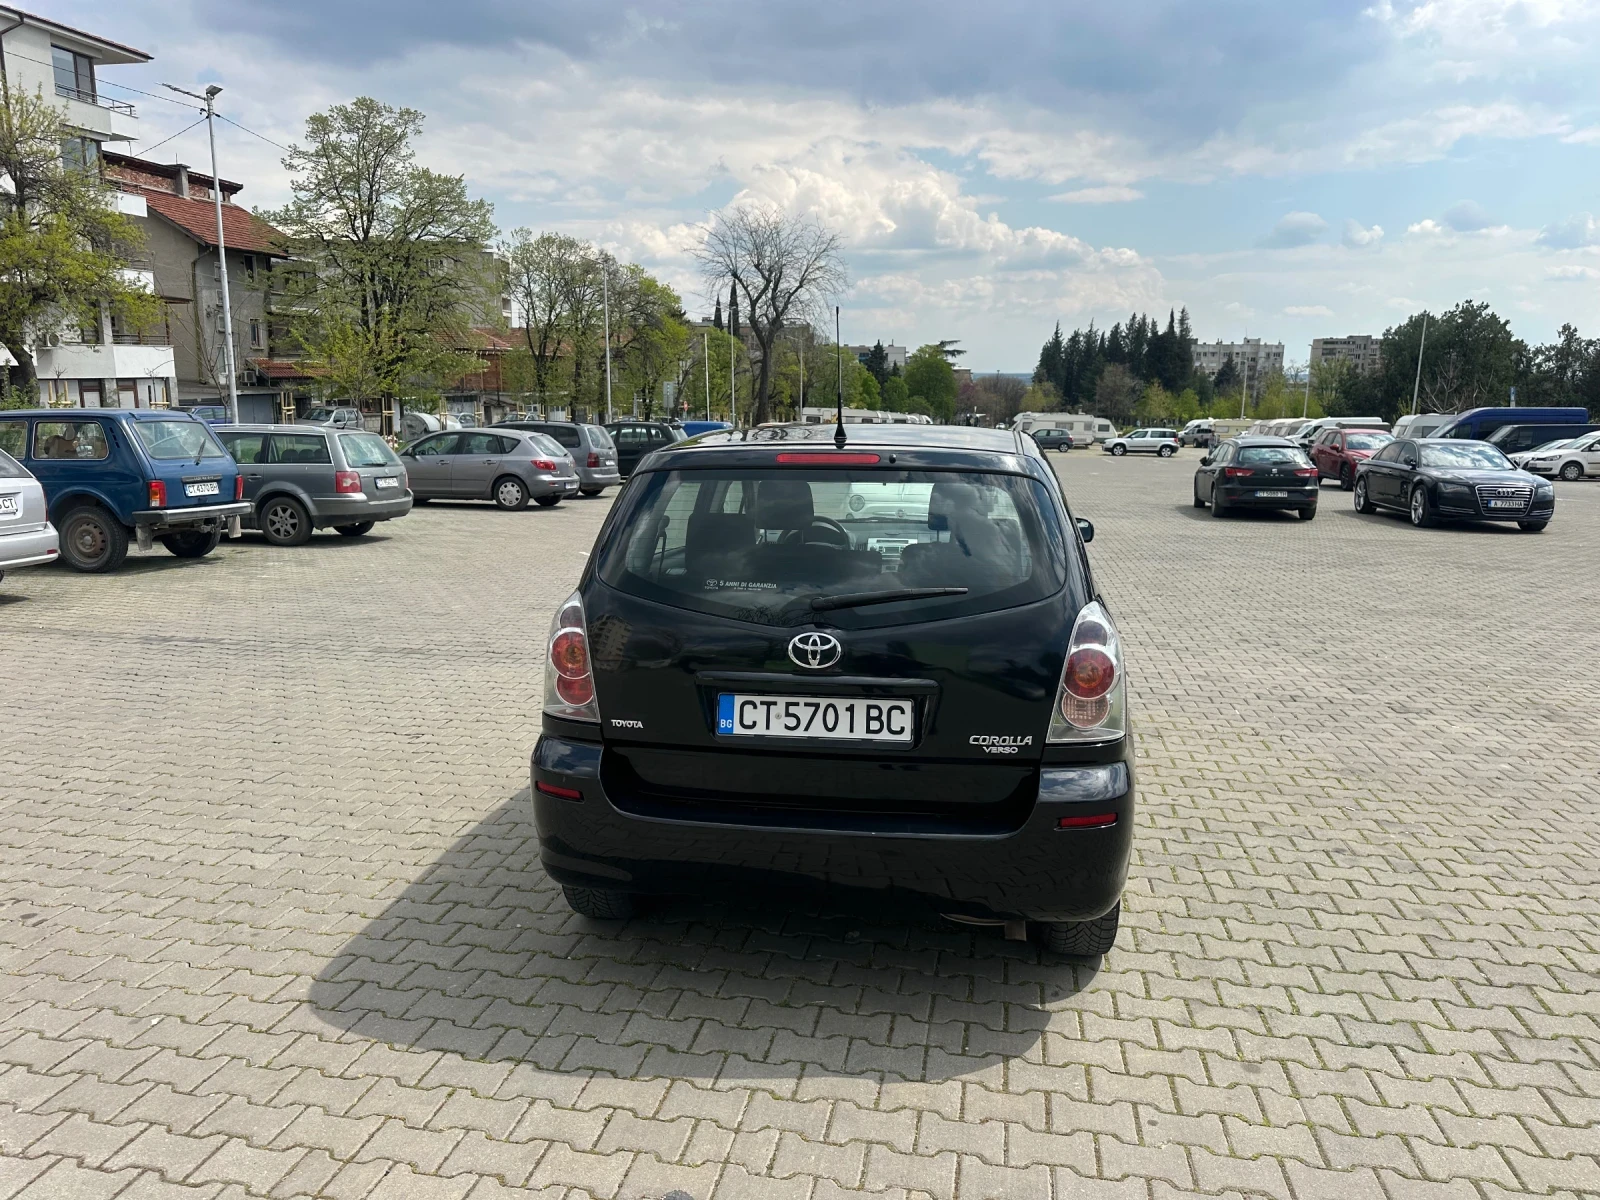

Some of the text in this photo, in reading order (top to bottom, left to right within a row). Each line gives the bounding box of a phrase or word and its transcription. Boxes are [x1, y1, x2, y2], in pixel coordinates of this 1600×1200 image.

[610, 719, 644, 729] TOYOTA
[720, 719, 733, 729] BG
[968, 735, 1033, 746] COROLLA
[982, 746, 1019, 754] VERSO
